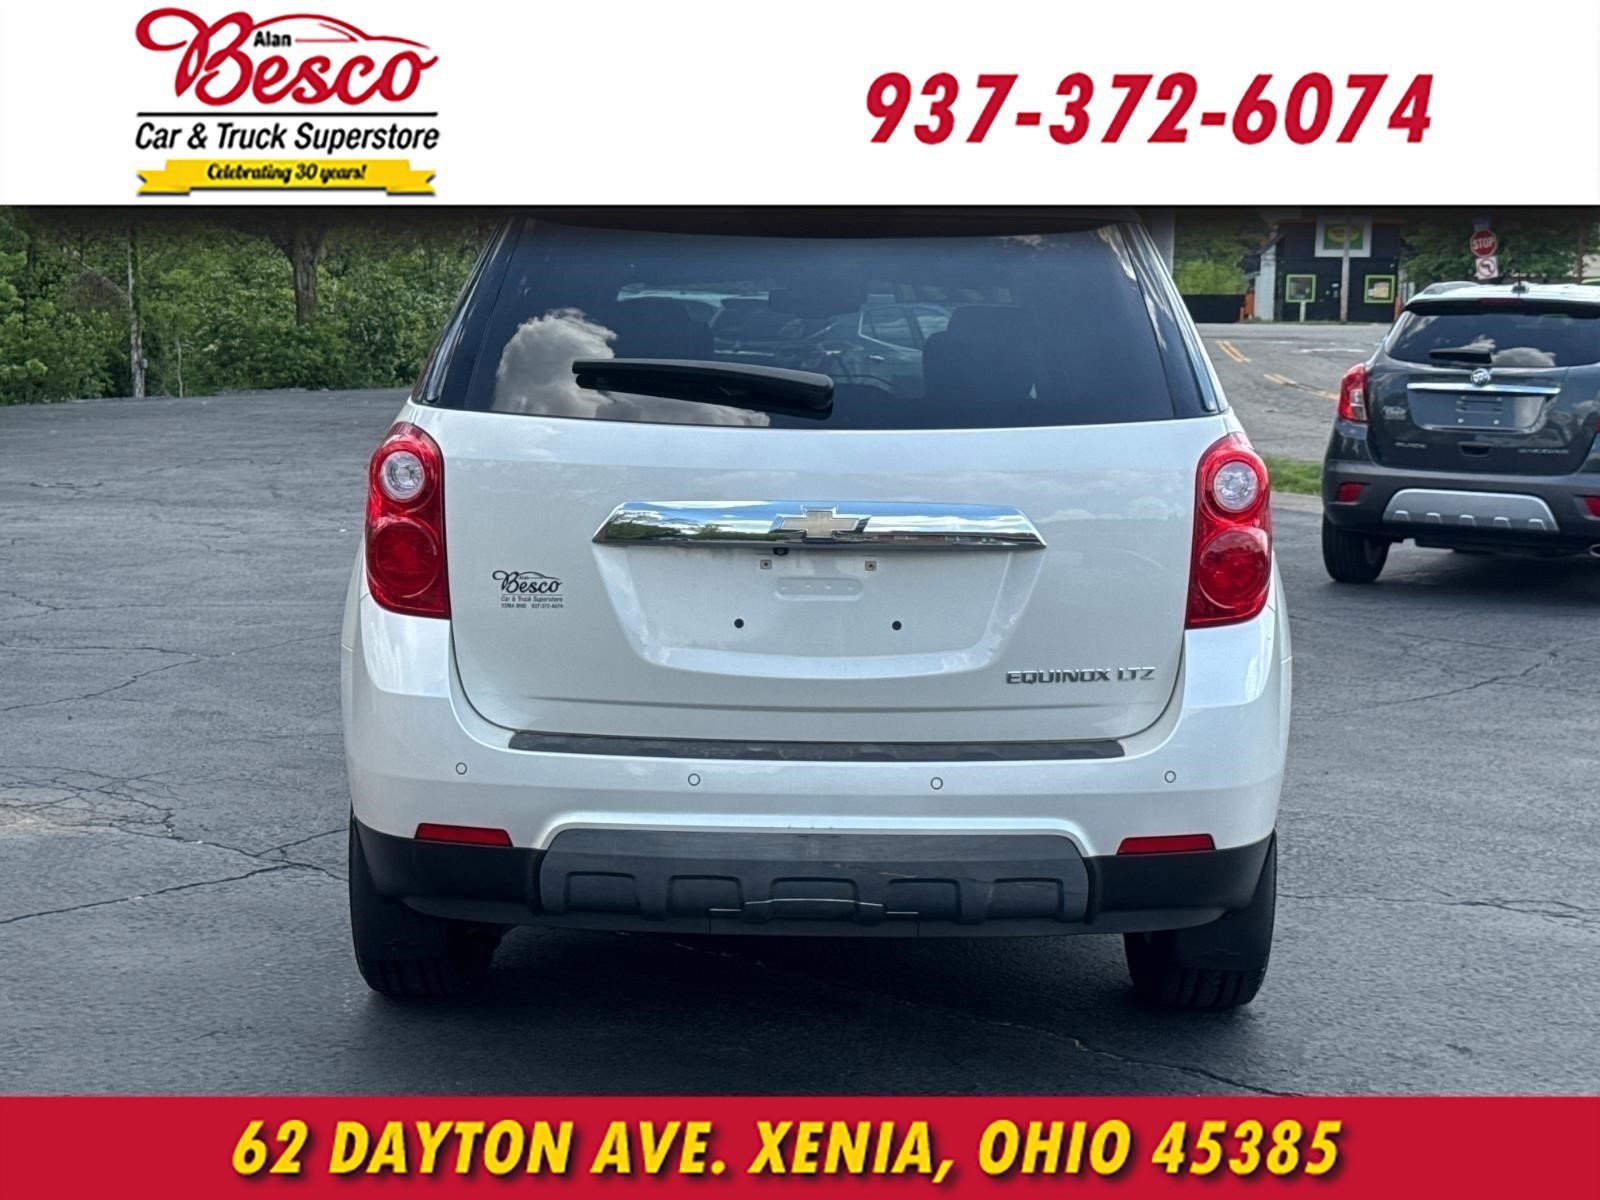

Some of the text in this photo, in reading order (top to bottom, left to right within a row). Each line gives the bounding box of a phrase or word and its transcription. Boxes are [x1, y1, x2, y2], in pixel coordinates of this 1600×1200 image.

[1472, 236, 1494, 250] STOP
[492, 570, 562, 594] Besco
[1006, 666, 1156, 684] EQUINOX LTZ
